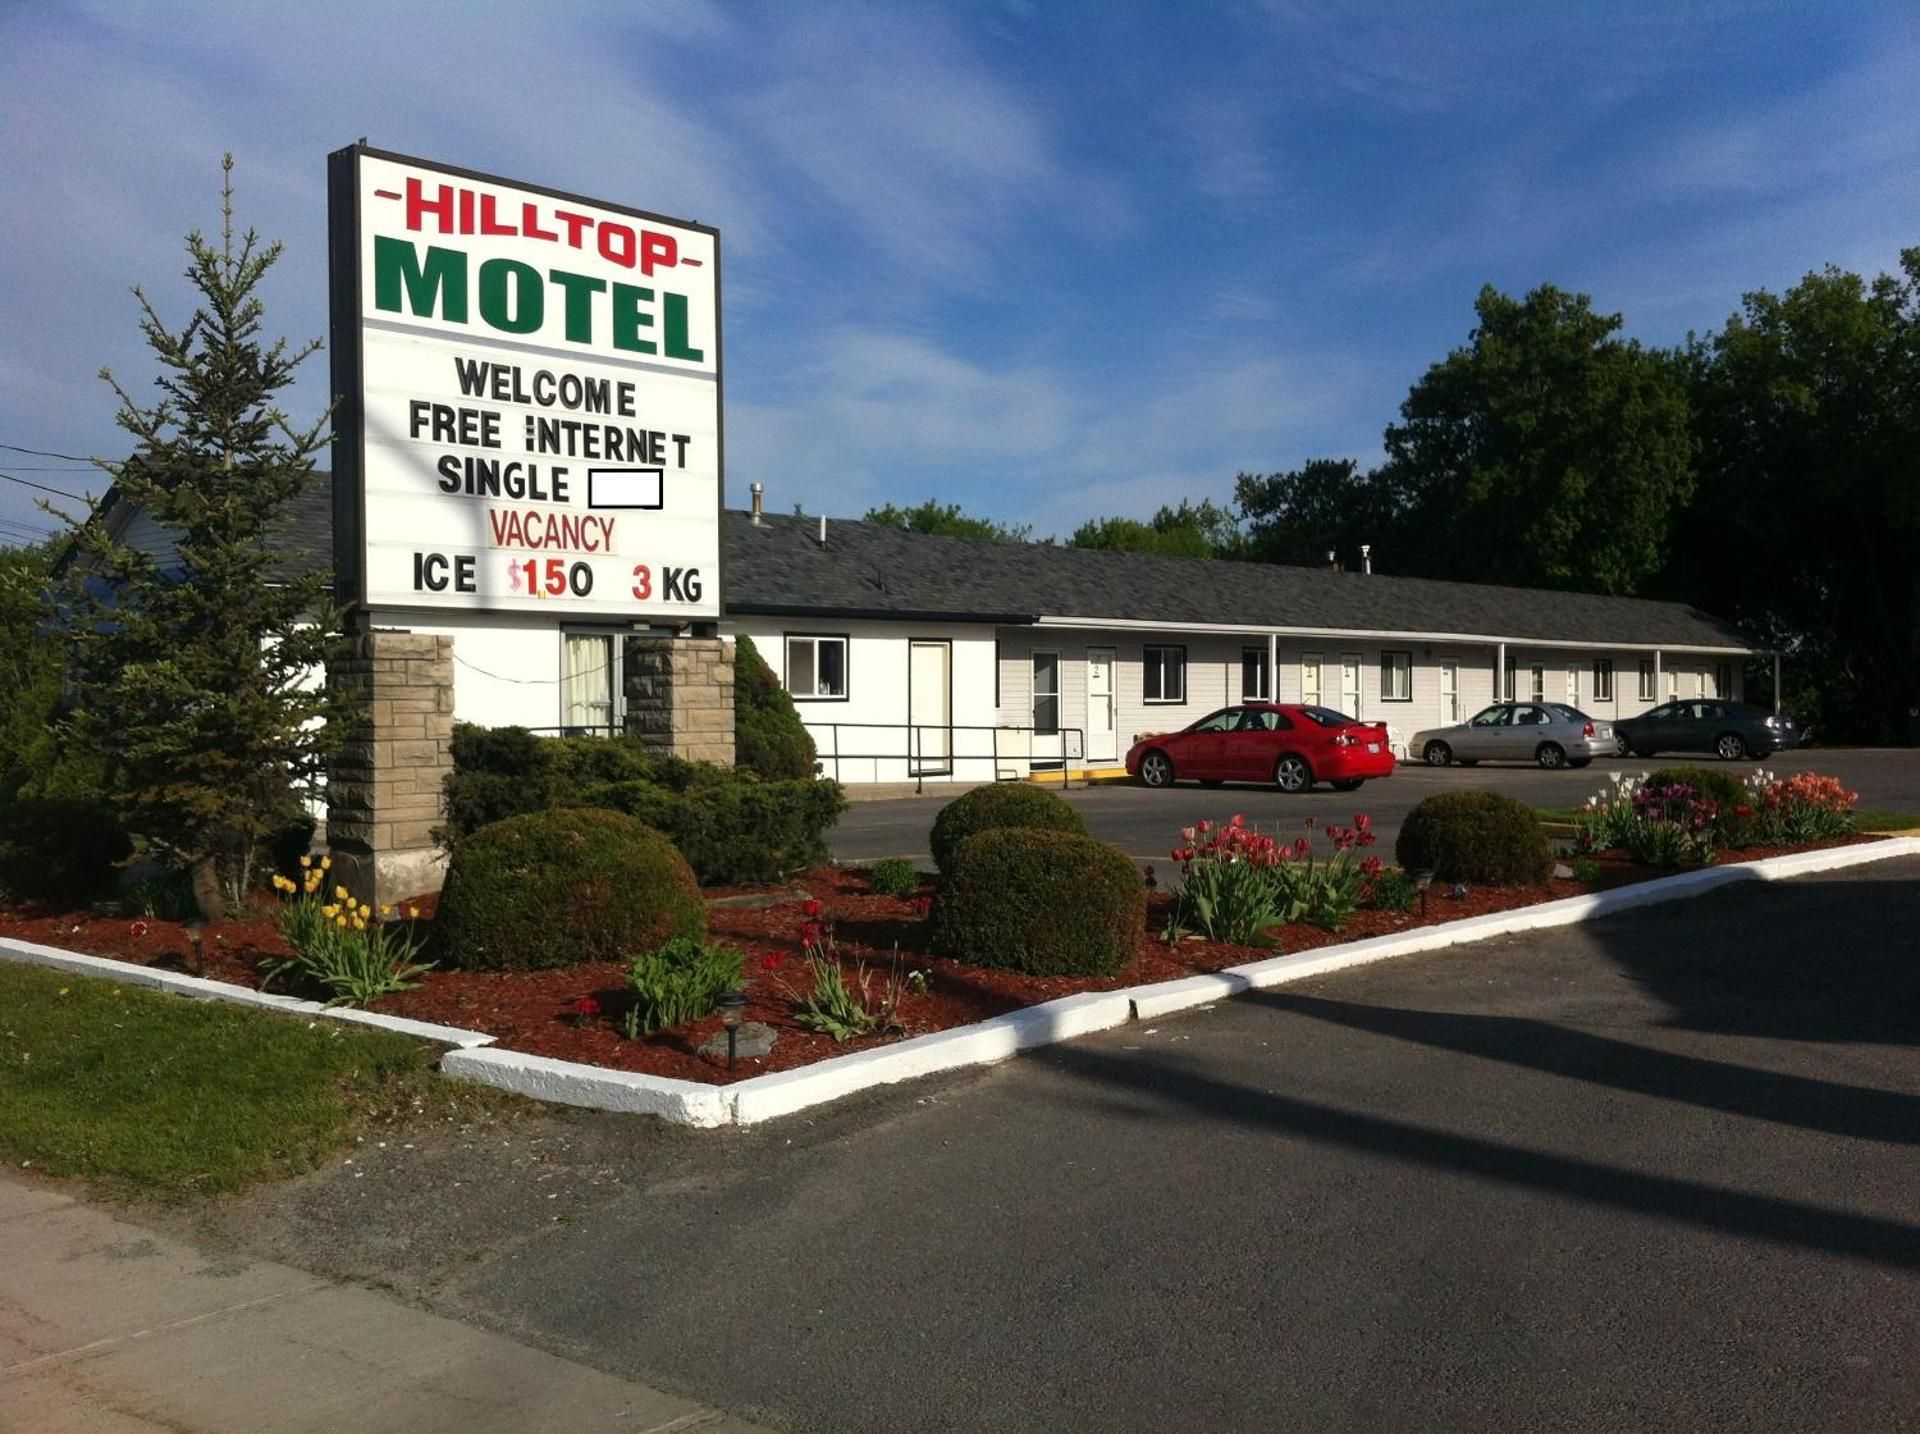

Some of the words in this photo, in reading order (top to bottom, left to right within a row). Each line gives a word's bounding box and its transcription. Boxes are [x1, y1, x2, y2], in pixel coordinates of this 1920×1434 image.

[374, 234, 704, 363] MOTEL
[454, 357, 636, 417] WELCOME
[409, 400, 502, 449] FREE
[524, 415, 691, 469] INTERNET
[437, 455, 570, 502] SINGLE
[490, 510, 615, 552] VACANCY
[413, 552, 477, 593] ICE
[632, 564, 652, 600] 3
[662, 566, 702, 603] KG
